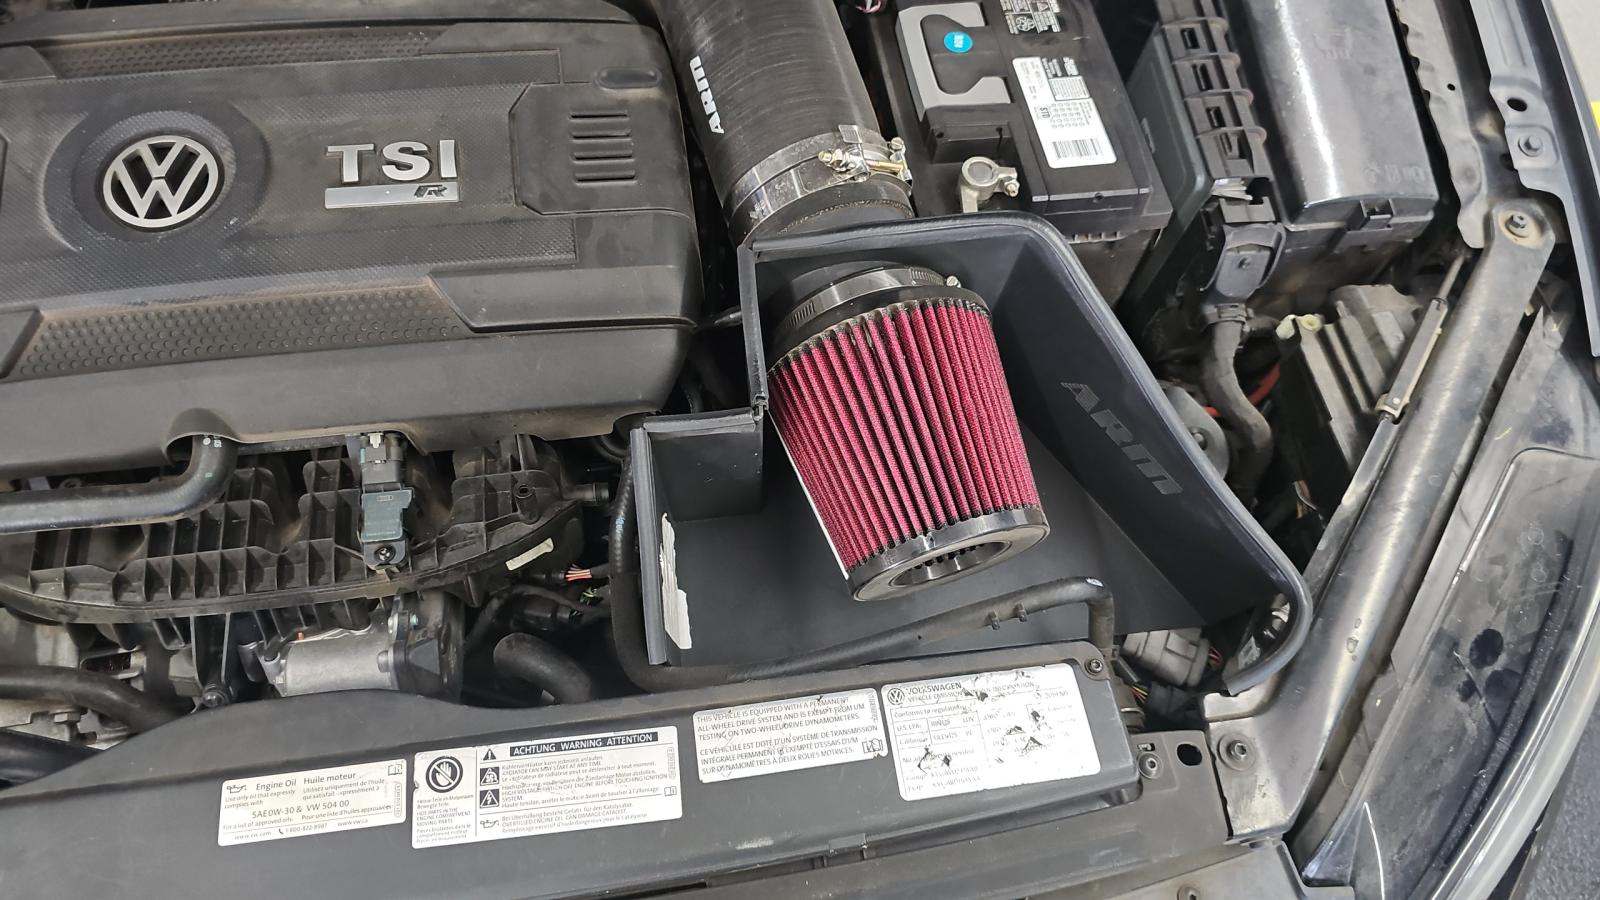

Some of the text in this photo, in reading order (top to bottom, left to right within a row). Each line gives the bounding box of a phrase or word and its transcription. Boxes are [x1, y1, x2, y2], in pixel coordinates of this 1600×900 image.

[327, 139, 457, 182] TSI
[905, 681, 962, 695] VOLKSWAGEN
[697, 715, 712, 723] THIS
[713, 711, 741, 720] VEHICLE
[749, 705, 783, 716] EQUIPPED
[784, 703, 802, 711] WITH
[809, 696, 849, 707] PERMANENT
[697, 721, 735, 731] ALL-WHEEL
[736, 718, 755, 726] DRIVE
[783, 712, 799, 720] AND
[807, 708, 832, 716] EXEMPT
[833, 705, 853, 713] FROM
[513, 733, 652, 755] ACHTUNG WARNING ATTENTION
[698, 731, 726, 740] TESTING
[742, 741, 753, 749] EST
[774, 736, 791, 745] D'UN
[830, 724, 877, 736] TRANSMISSION
[701, 766, 716, 774] SUR
[778, 755, 796, 763] DEUX
[256, 780, 283, 792] Engine
[303, 775, 324, 784] Huile
[326, 772, 355, 781] moteur
[296, 805, 302, 813] &
[306, 803, 320, 812] VW
[322, 801, 337, 810] 504
[338, 799, 349, 808] 00
